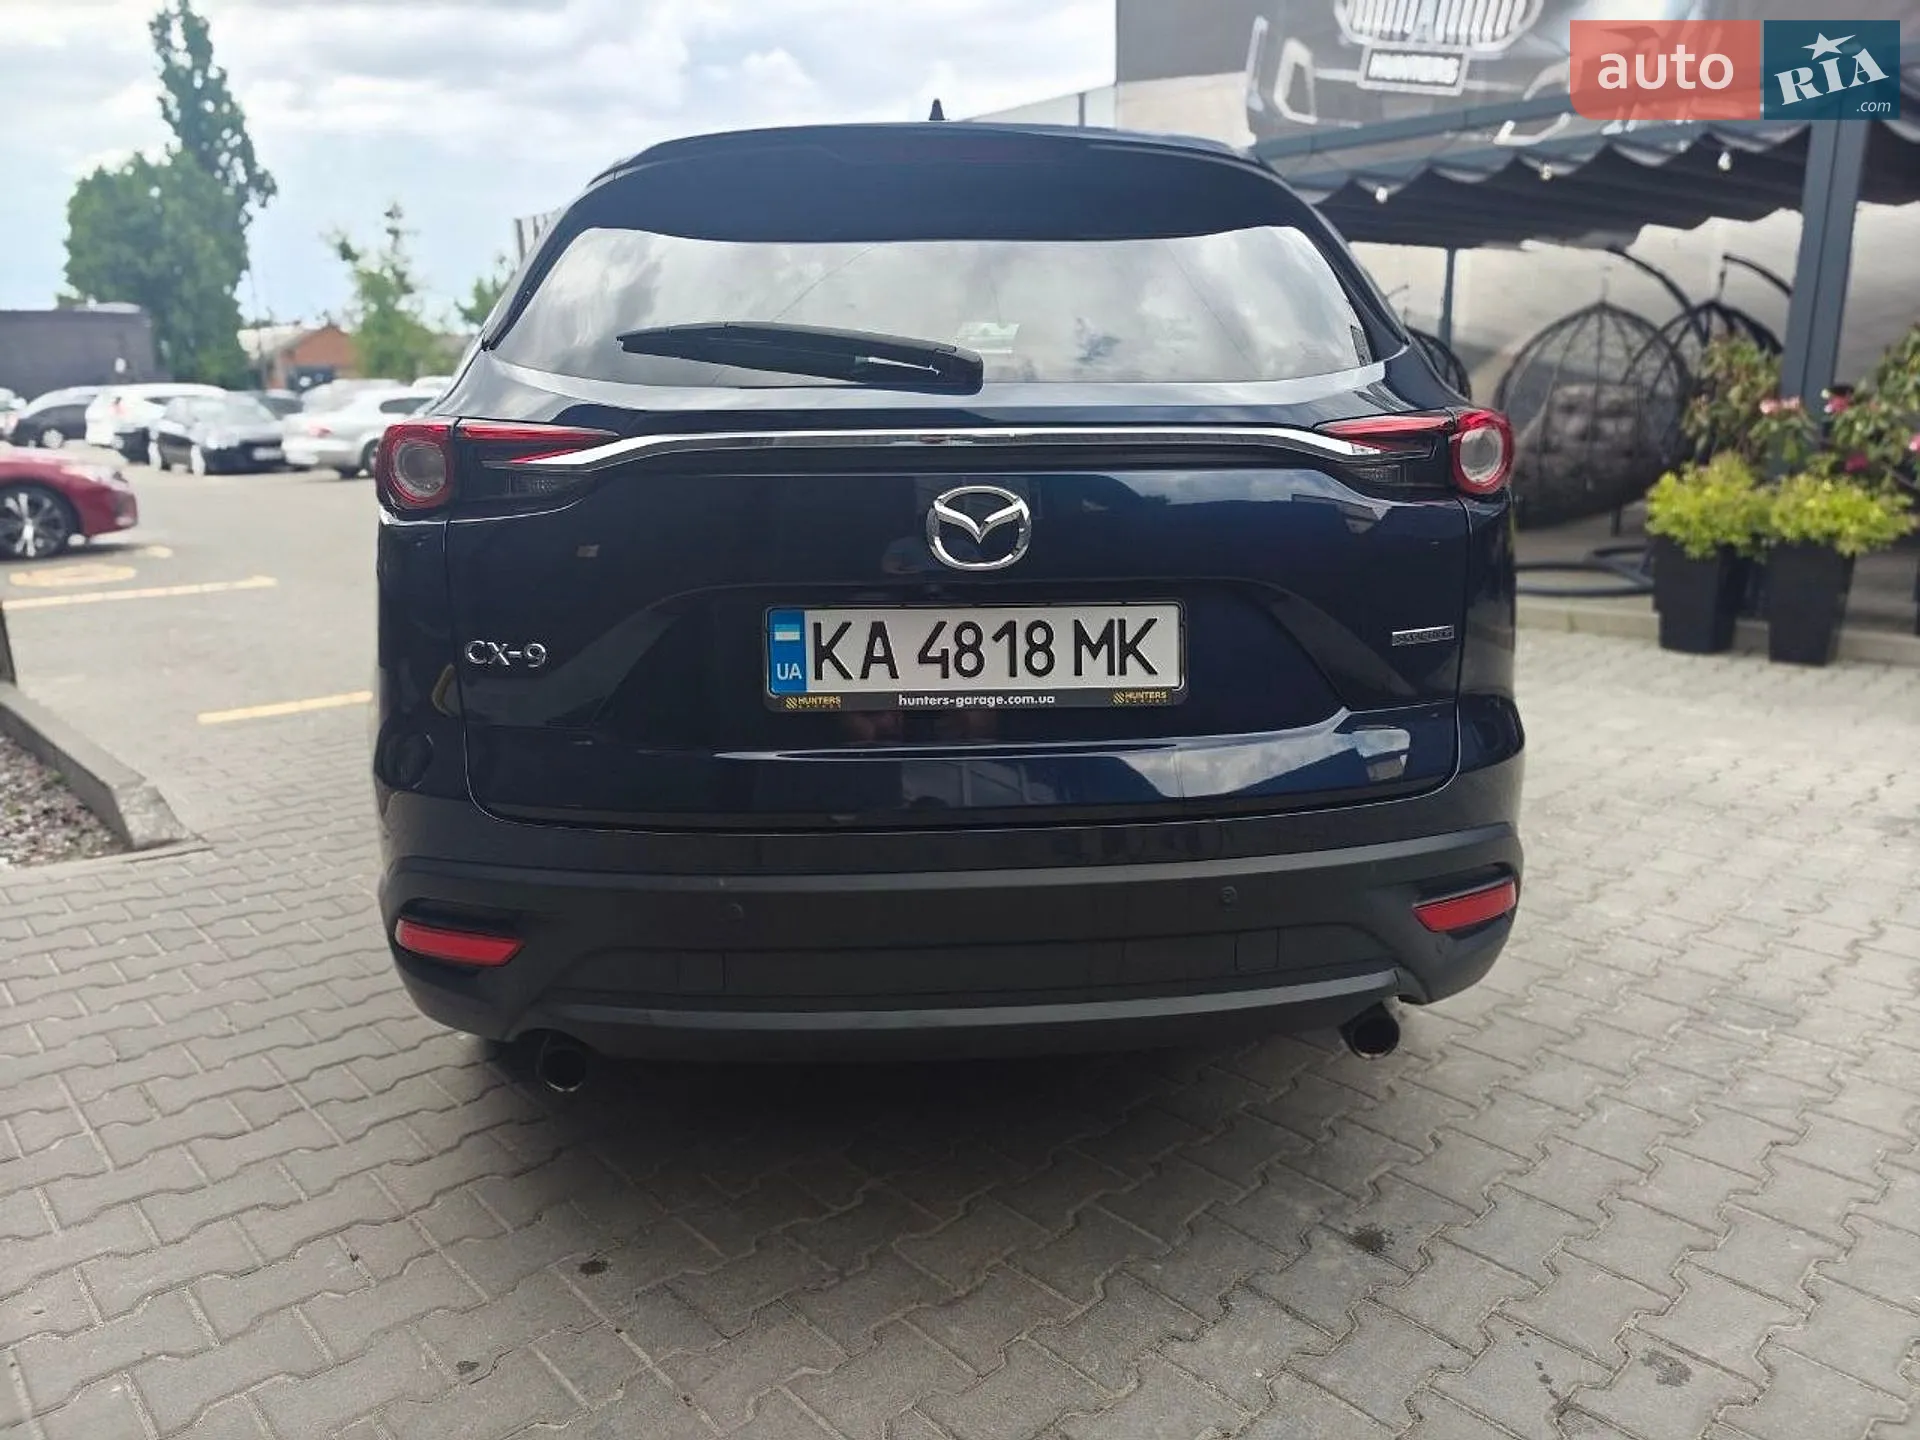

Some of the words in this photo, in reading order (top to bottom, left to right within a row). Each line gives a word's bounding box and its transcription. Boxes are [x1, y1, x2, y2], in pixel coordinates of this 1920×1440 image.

[465, 640, 546, 667] CX-9
[813, 621, 899, 680] KA
[918, 620, 1055, 678] 4818
[1074, 618, 1158, 676] MK
[776, 663, 802, 680] UA
[798, 696, 841, 705] HUNTERS
[898, 694, 1056, 708] hunters-garage.com.ua
[1125, 691, 1167, 699] HUNTERS
